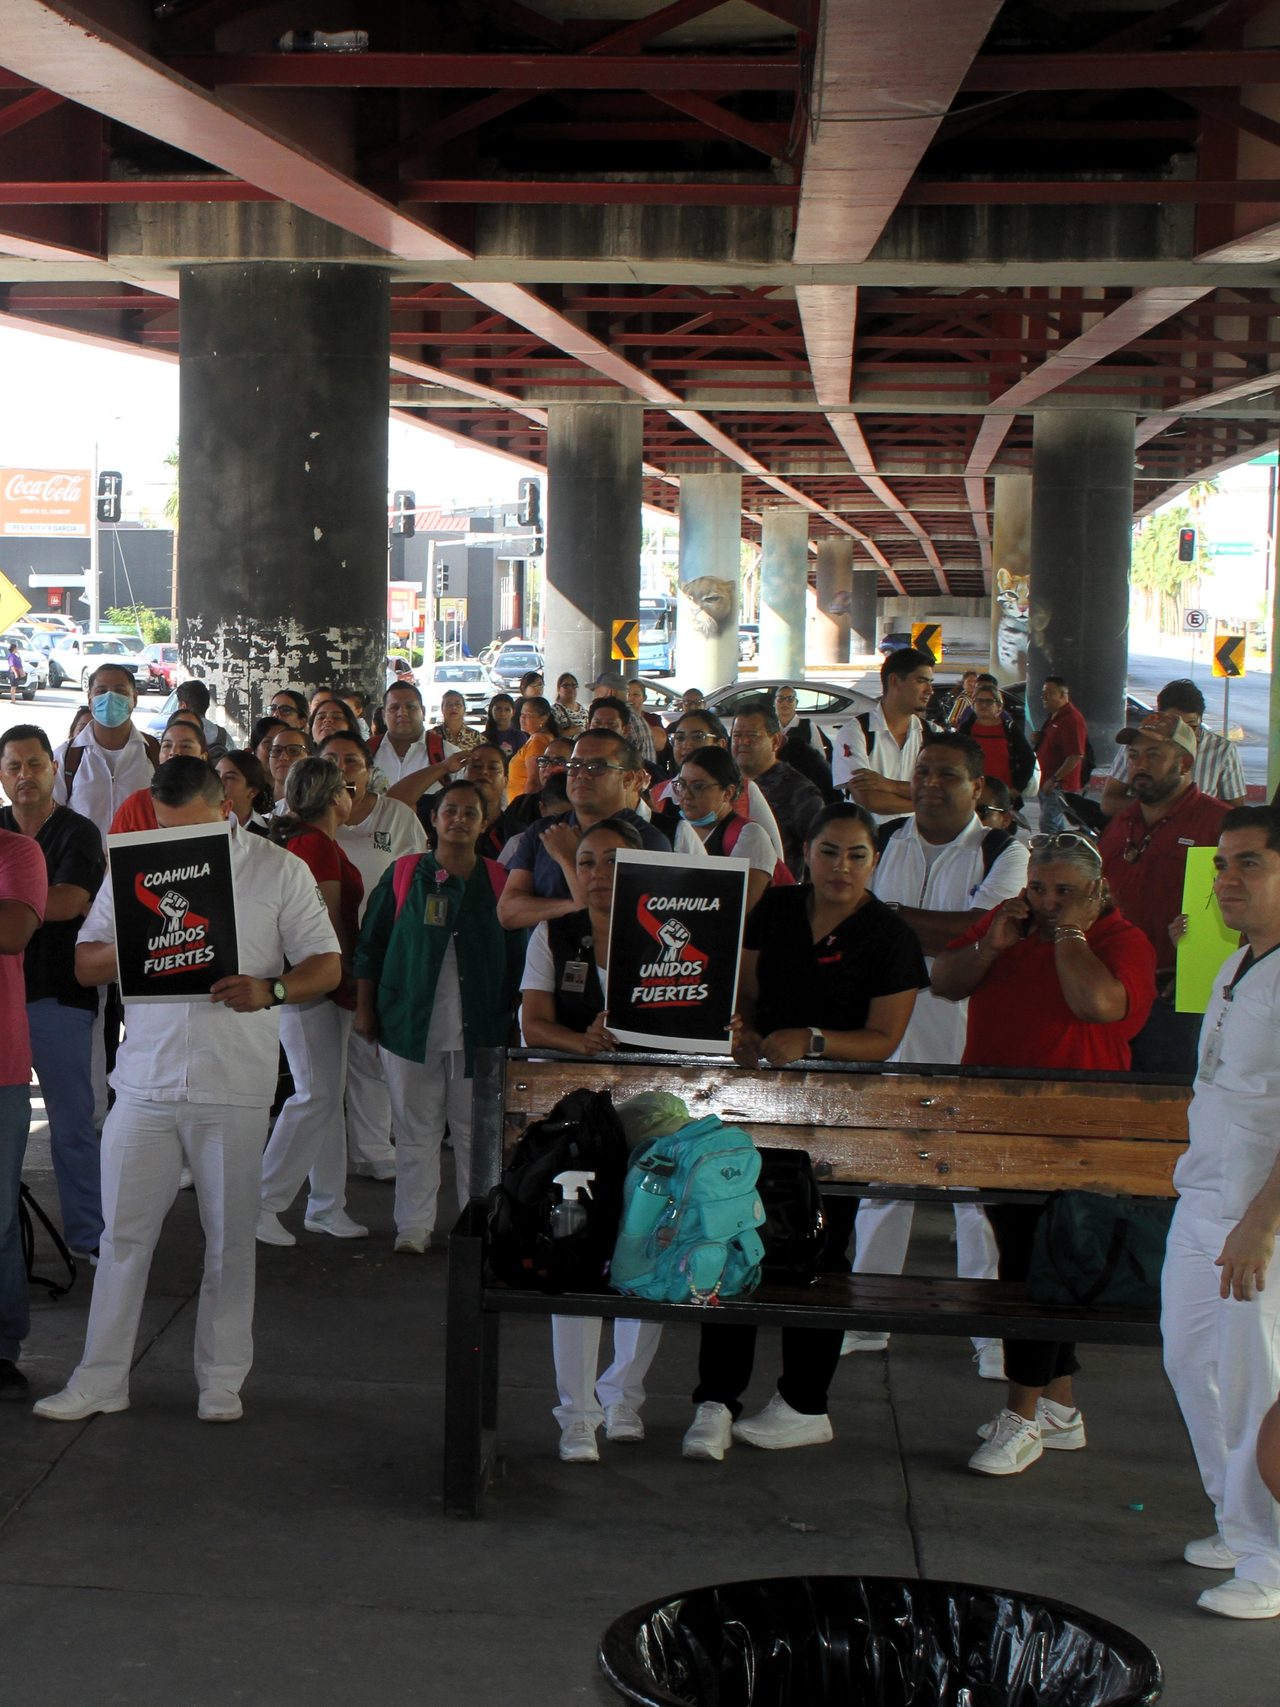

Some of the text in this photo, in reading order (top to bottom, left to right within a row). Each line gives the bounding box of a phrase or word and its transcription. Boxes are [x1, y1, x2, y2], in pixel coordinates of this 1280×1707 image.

[5, 474, 85, 502] Coca-Cola
[143, 862, 211, 887] COAHUILA
[646, 897, 720, 912] COAHUILA
[147, 925, 205, 951] UNIDOS
[144, 945, 215, 974] FUERTES
[639, 961, 703, 978] UNIDOS
[631, 984, 709, 1004] FUERTES
